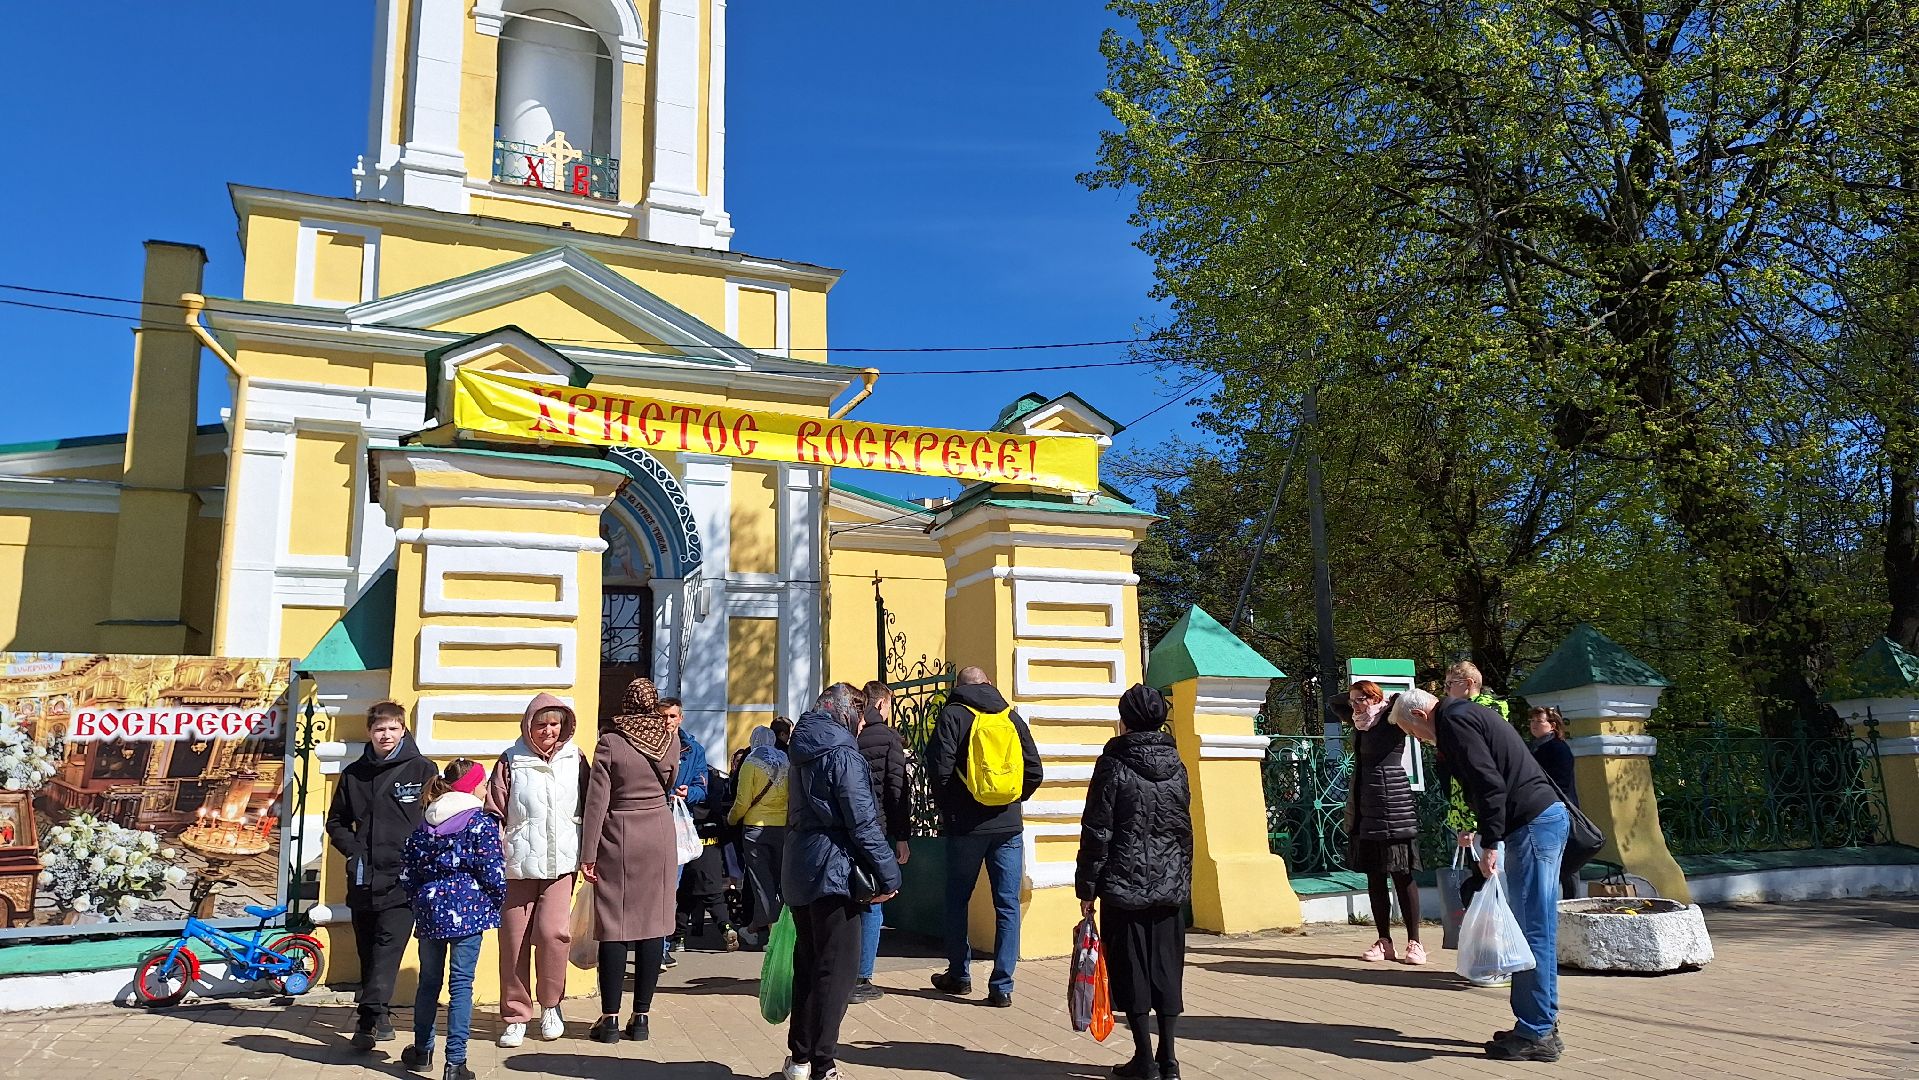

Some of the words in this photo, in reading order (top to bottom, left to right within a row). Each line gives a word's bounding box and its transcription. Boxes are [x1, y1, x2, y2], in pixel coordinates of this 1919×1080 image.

[524, 155, 544, 189] Х
[529, 386, 759, 456] ХРИСТОС
[796, 420, 1038, 481] ВОСКРЕСЕ!
[73, 711, 278, 737] ВОСКРЕСЕ!
